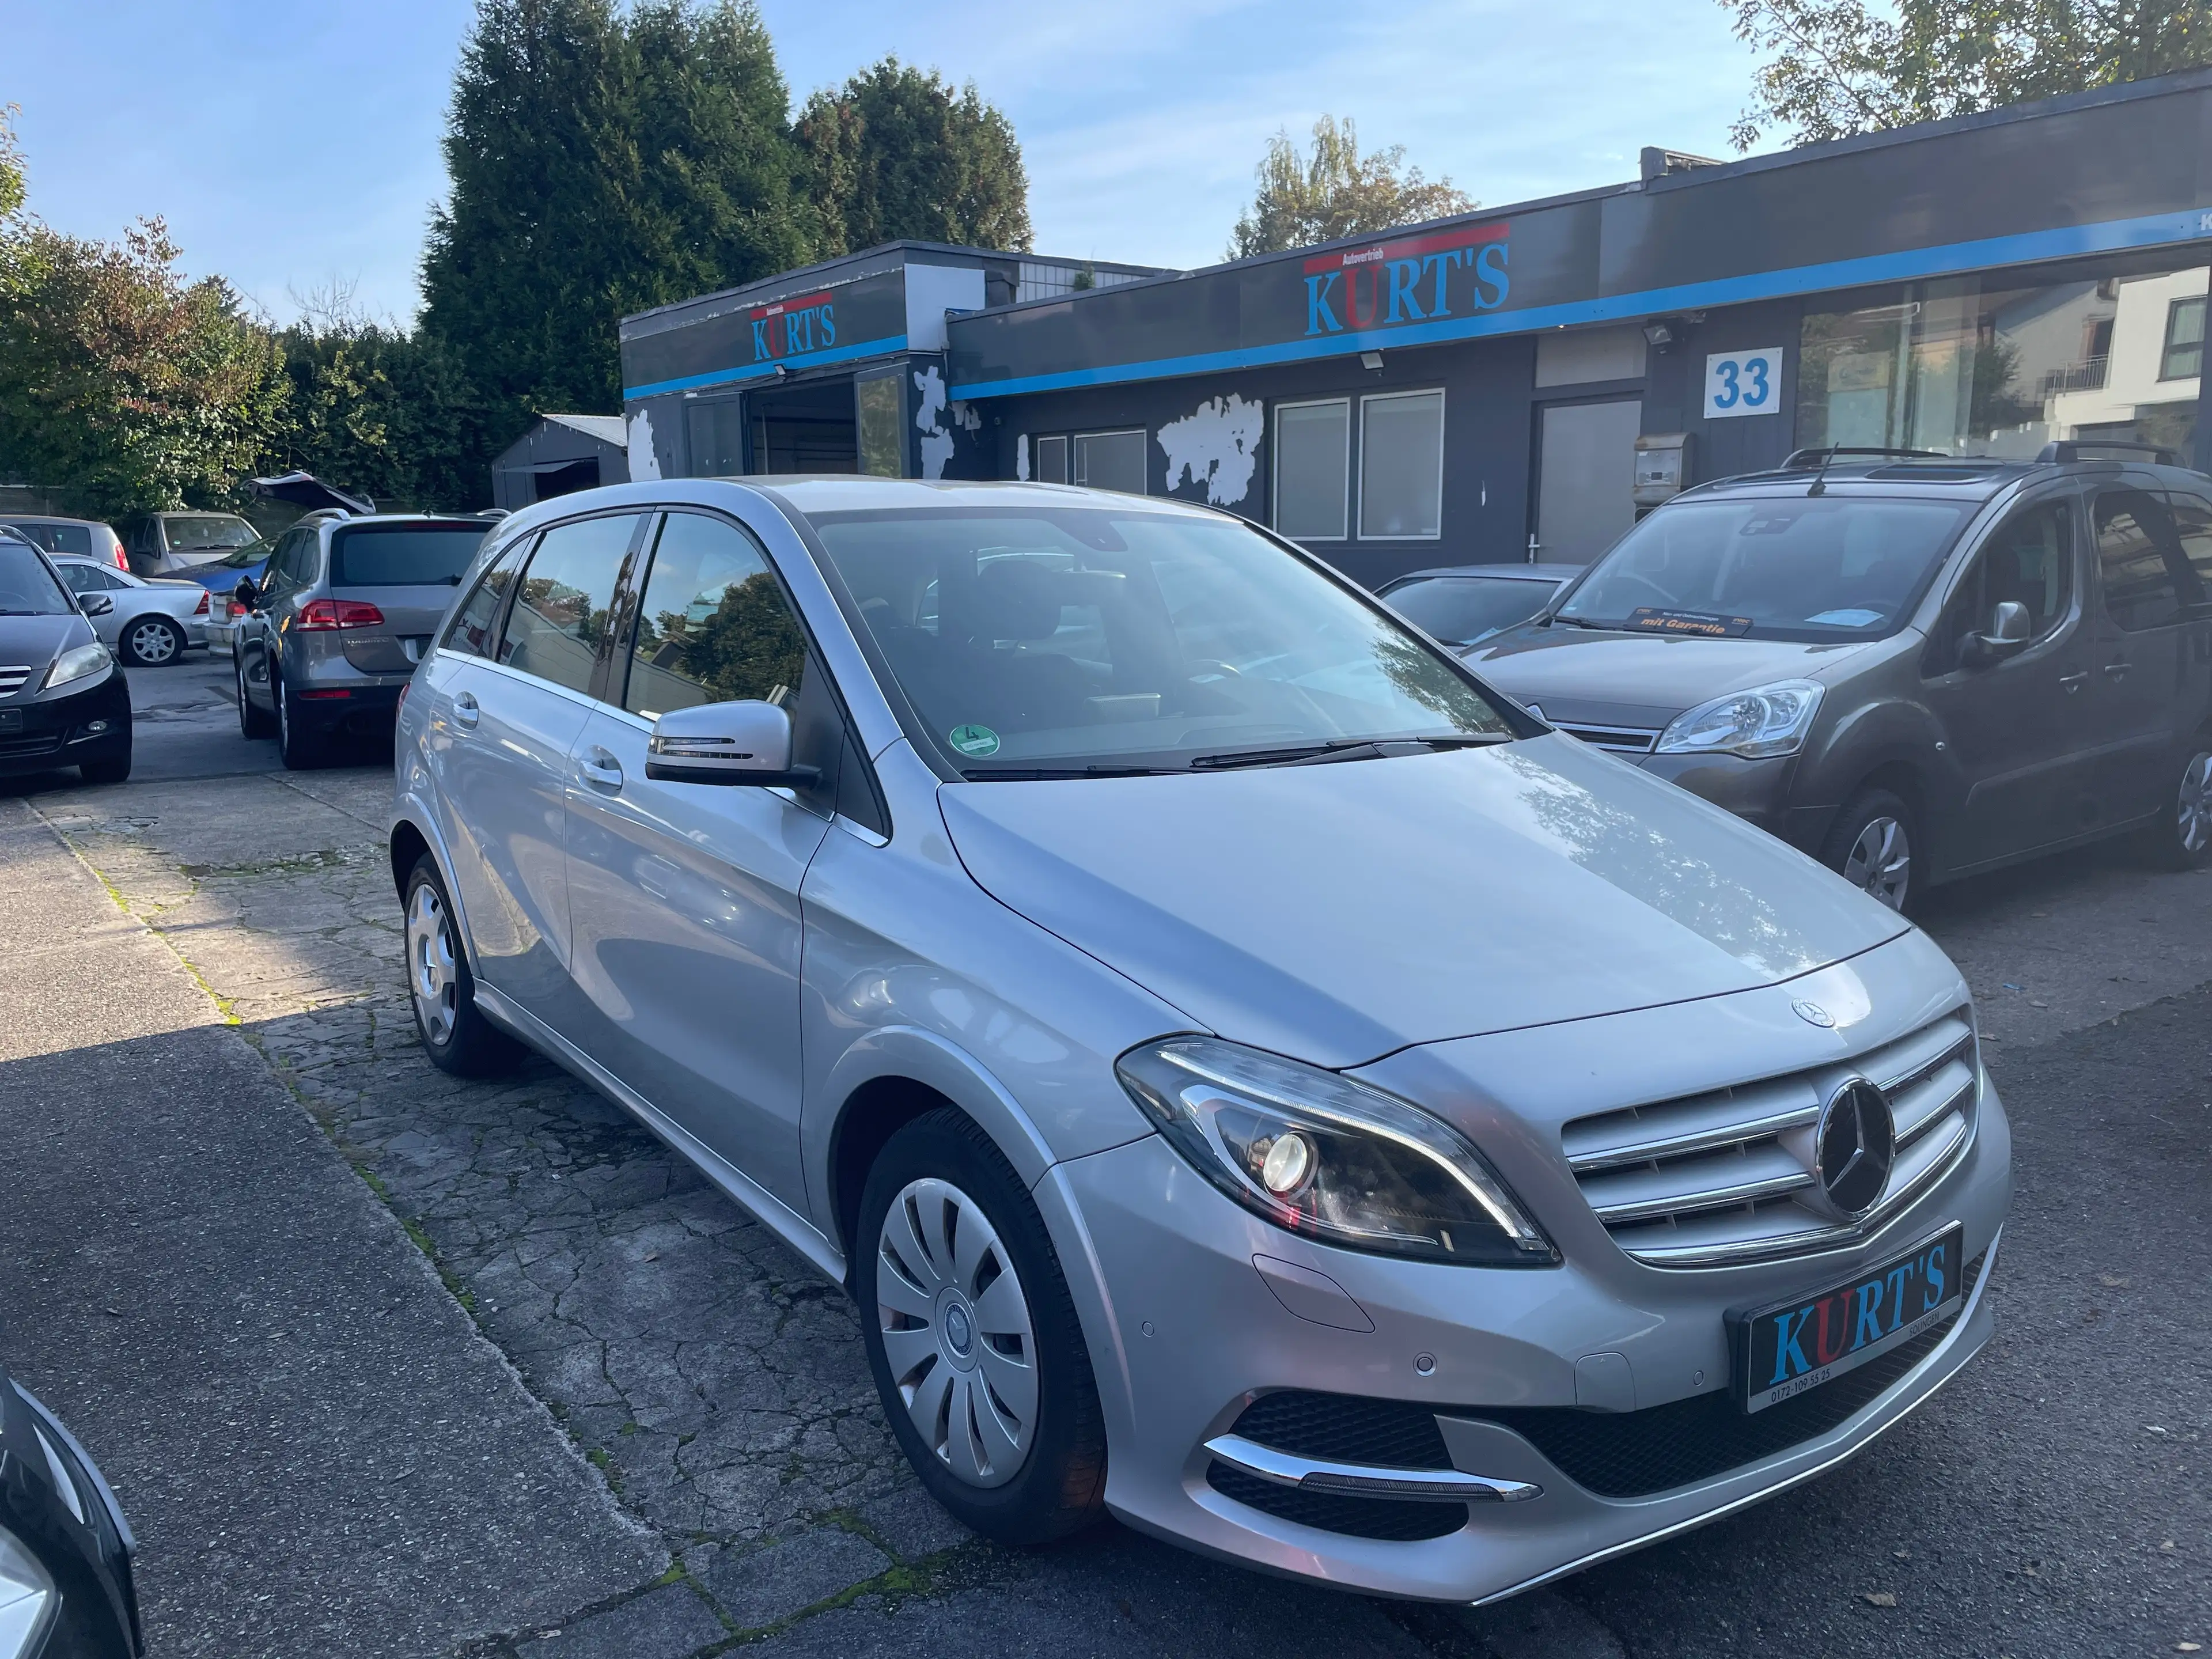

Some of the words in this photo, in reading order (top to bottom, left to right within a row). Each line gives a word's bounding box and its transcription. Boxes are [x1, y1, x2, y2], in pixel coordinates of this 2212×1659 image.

[1342, 248, 1384, 266] Autovertrieb
[1304, 243, 1509, 336] KURT'S
[751, 304, 836, 361] KURT'S
[1714, 357, 1769, 409] 33
[1641, 618, 1665, 626] mit
[1769, 1243, 1946, 1385] KURT'S
[1910, 1311, 1940, 1337] SOLINGEN
[1771, 1378, 1808, 1403] 0172-109
[1810, 1373, 1819, 1386] 55
[1821, 1368, 1830, 1381] 25
